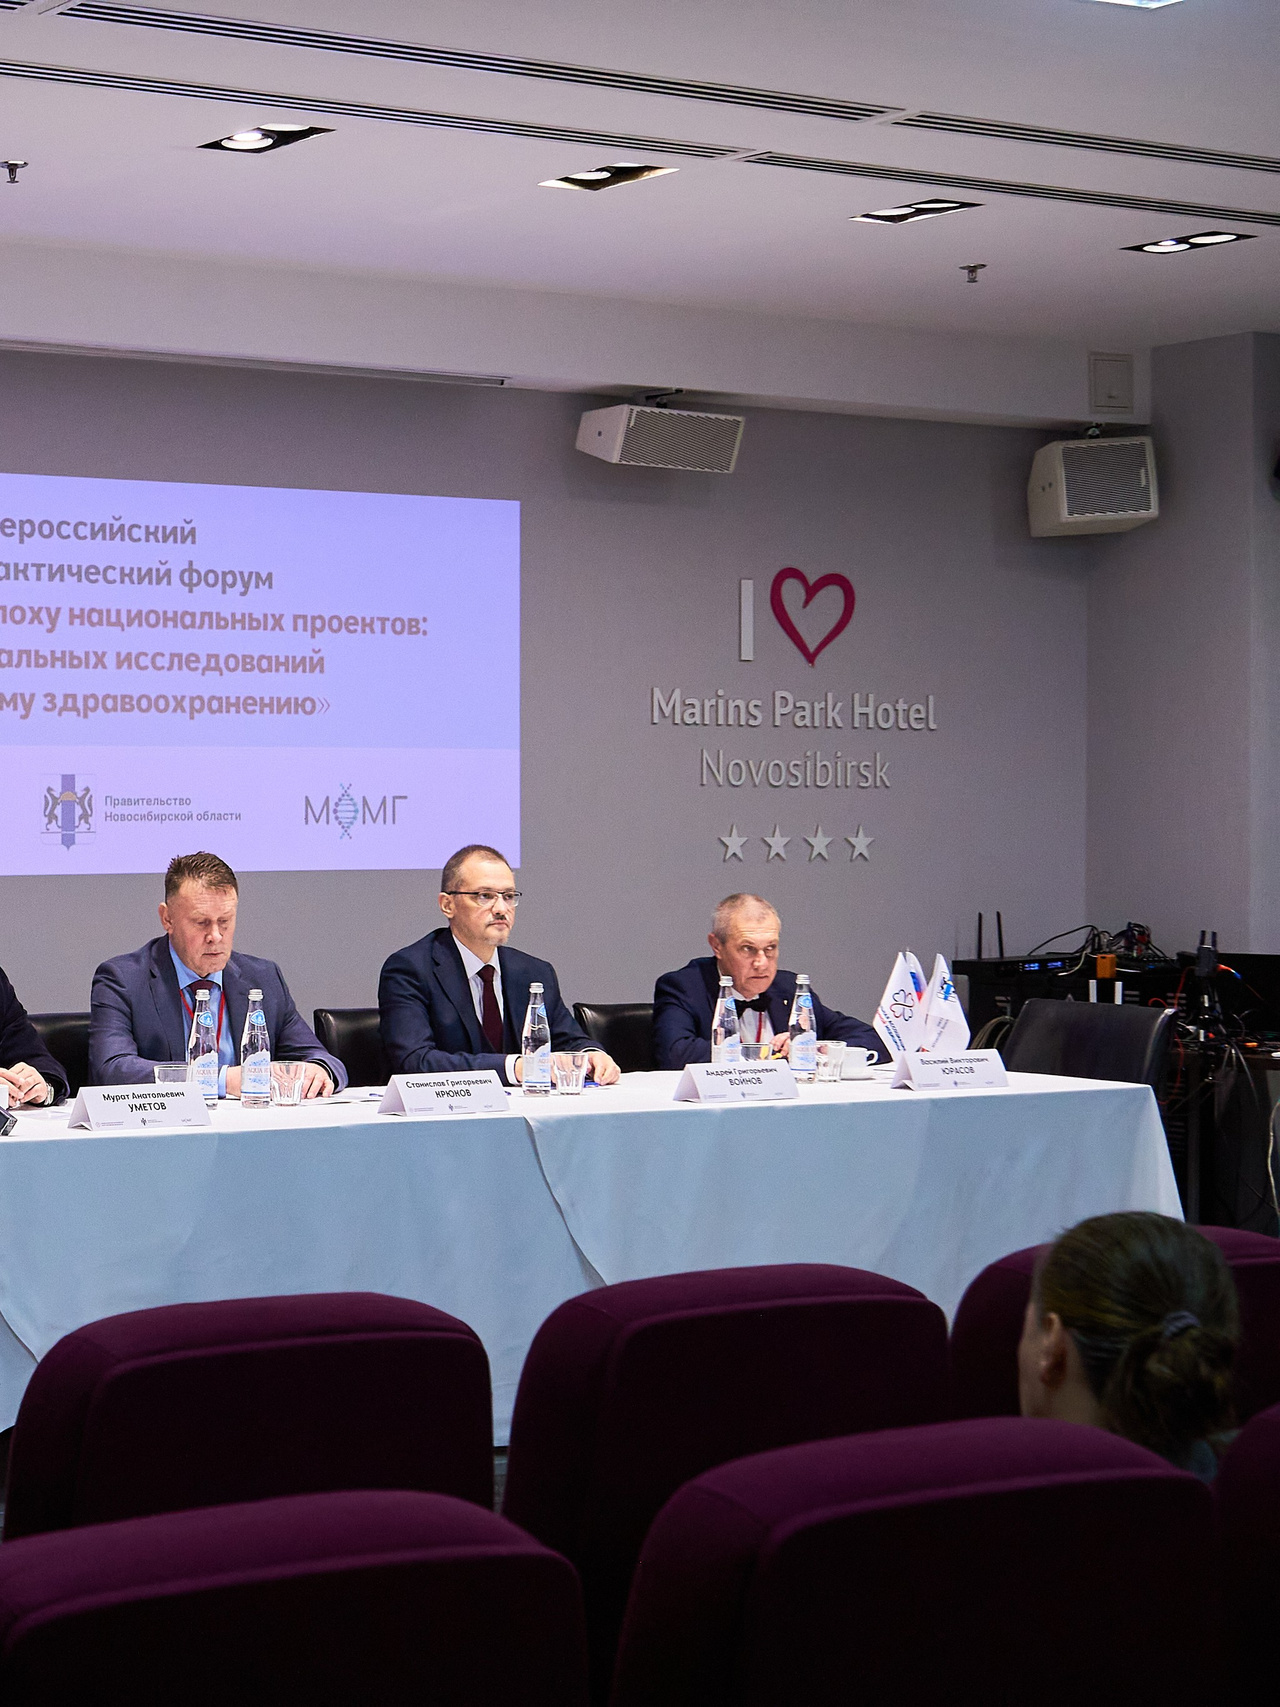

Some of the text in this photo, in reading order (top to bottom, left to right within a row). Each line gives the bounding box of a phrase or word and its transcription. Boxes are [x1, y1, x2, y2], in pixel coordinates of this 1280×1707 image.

[178, 559, 274, 597] форум
[68, 603, 286, 633] национальных
[292, 613, 429, 639] проектов:
[739, 578, 754, 661] I
[115, 648, 326, 677] исследований
[42, 692, 331, 721] здравоохранению»
[651, 686, 938, 731] Marins Park Hotel
[699, 748, 891, 788] Novosibirsk
[105, 796, 192, 809] Правительство
[105, 809, 242, 825] Новосибирской области
[919, 1056, 989, 1066] Василий Викторович
[705, 1066, 778, 1077] Андрей Григорьевич
[941, 1066, 975, 1075] ЮРАСОВ
[405, 1078, 493, 1090] Станислав Григорьевич
[102, 1090, 186, 1103] Мурат Анатольевич
[127, 1102, 167, 1112] УМЕТОВ
